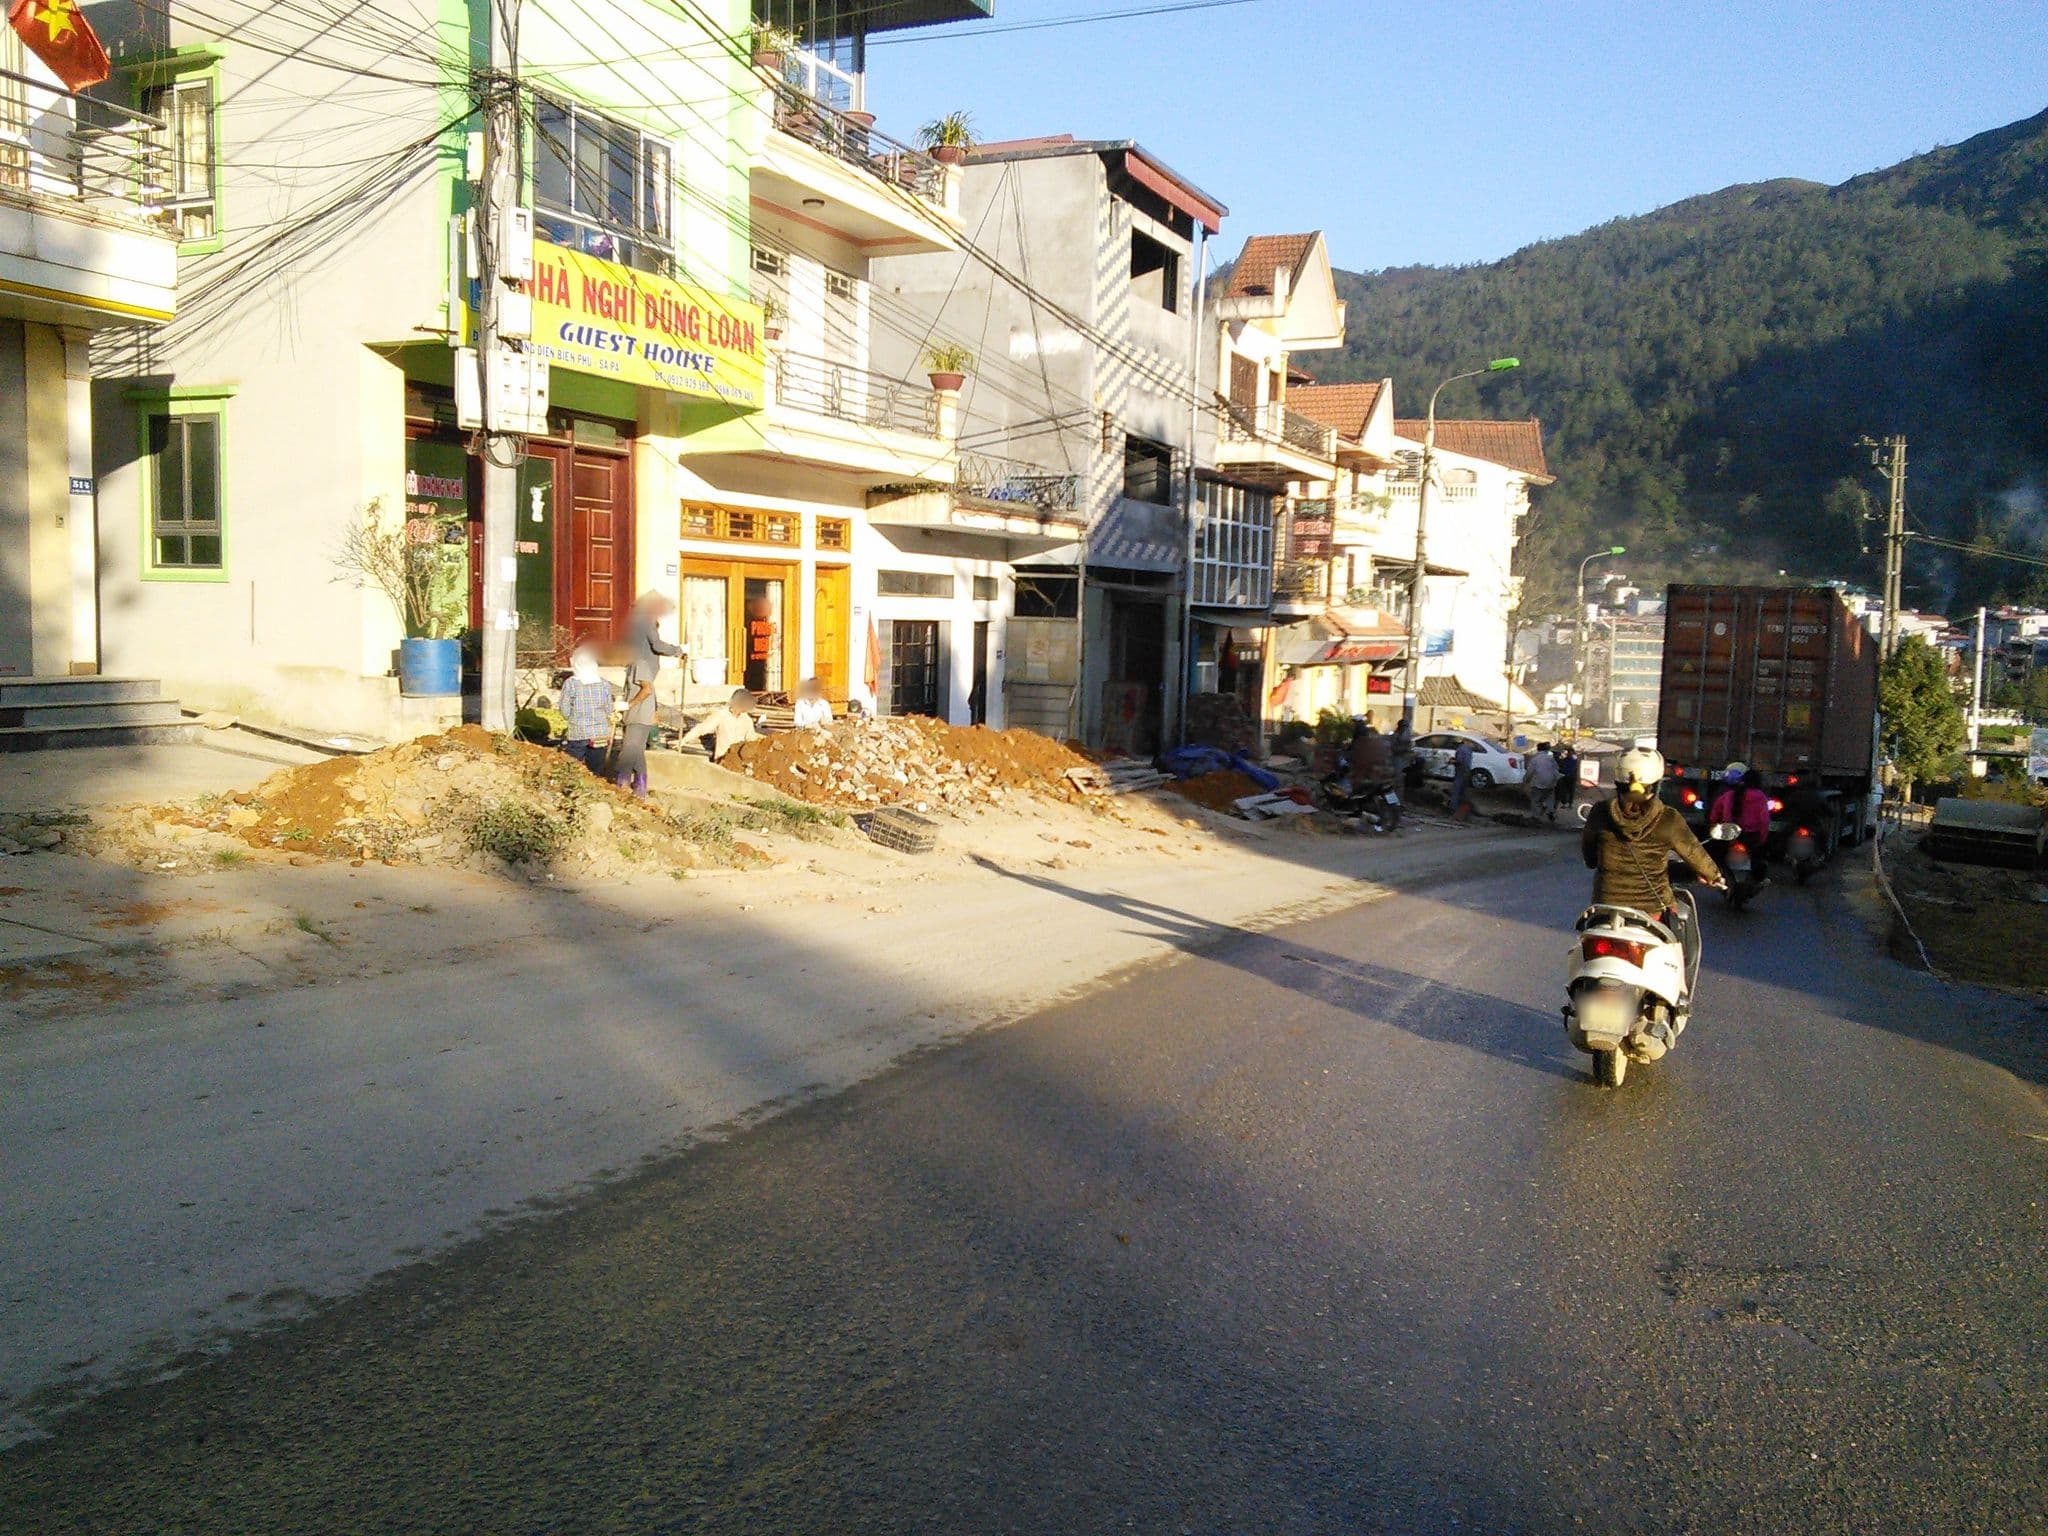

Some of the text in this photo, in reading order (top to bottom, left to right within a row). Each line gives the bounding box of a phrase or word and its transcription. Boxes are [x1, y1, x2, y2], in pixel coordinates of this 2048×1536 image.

[559, 321, 715, 374] GUEST HOUSE
[583, 273, 636, 326] NGHỈ
[645, 288, 701, 342] DŨNG
[707, 310, 755, 355] LOAN
